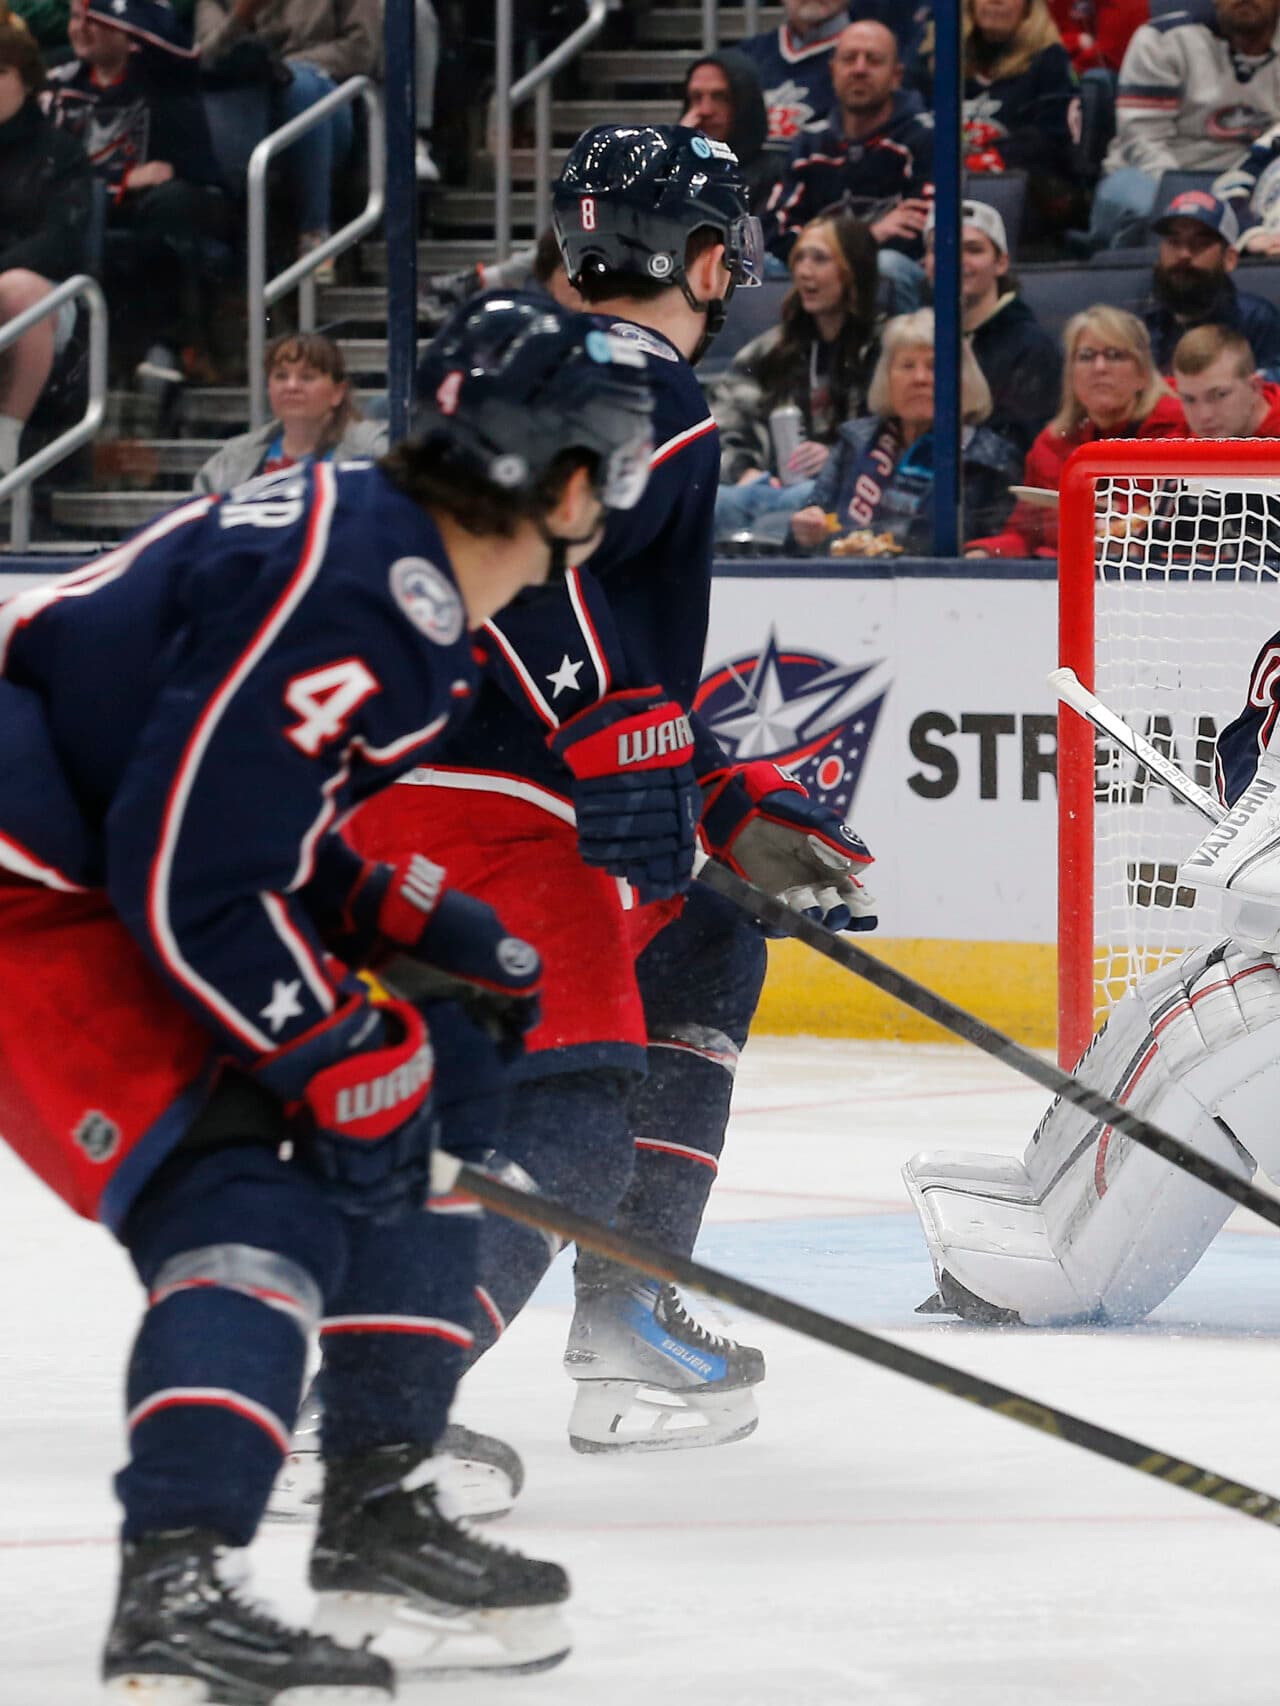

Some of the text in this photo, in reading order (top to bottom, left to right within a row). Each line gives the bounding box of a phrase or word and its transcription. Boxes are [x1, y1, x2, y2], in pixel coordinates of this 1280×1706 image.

[580, 196, 597, 232] 8
[848, 474, 881, 526] GO
[283, 655, 383, 758] 4
[1190, 778, 1277, 868] VAUGHN
[661, 1339, 713, 1374] BAUER
